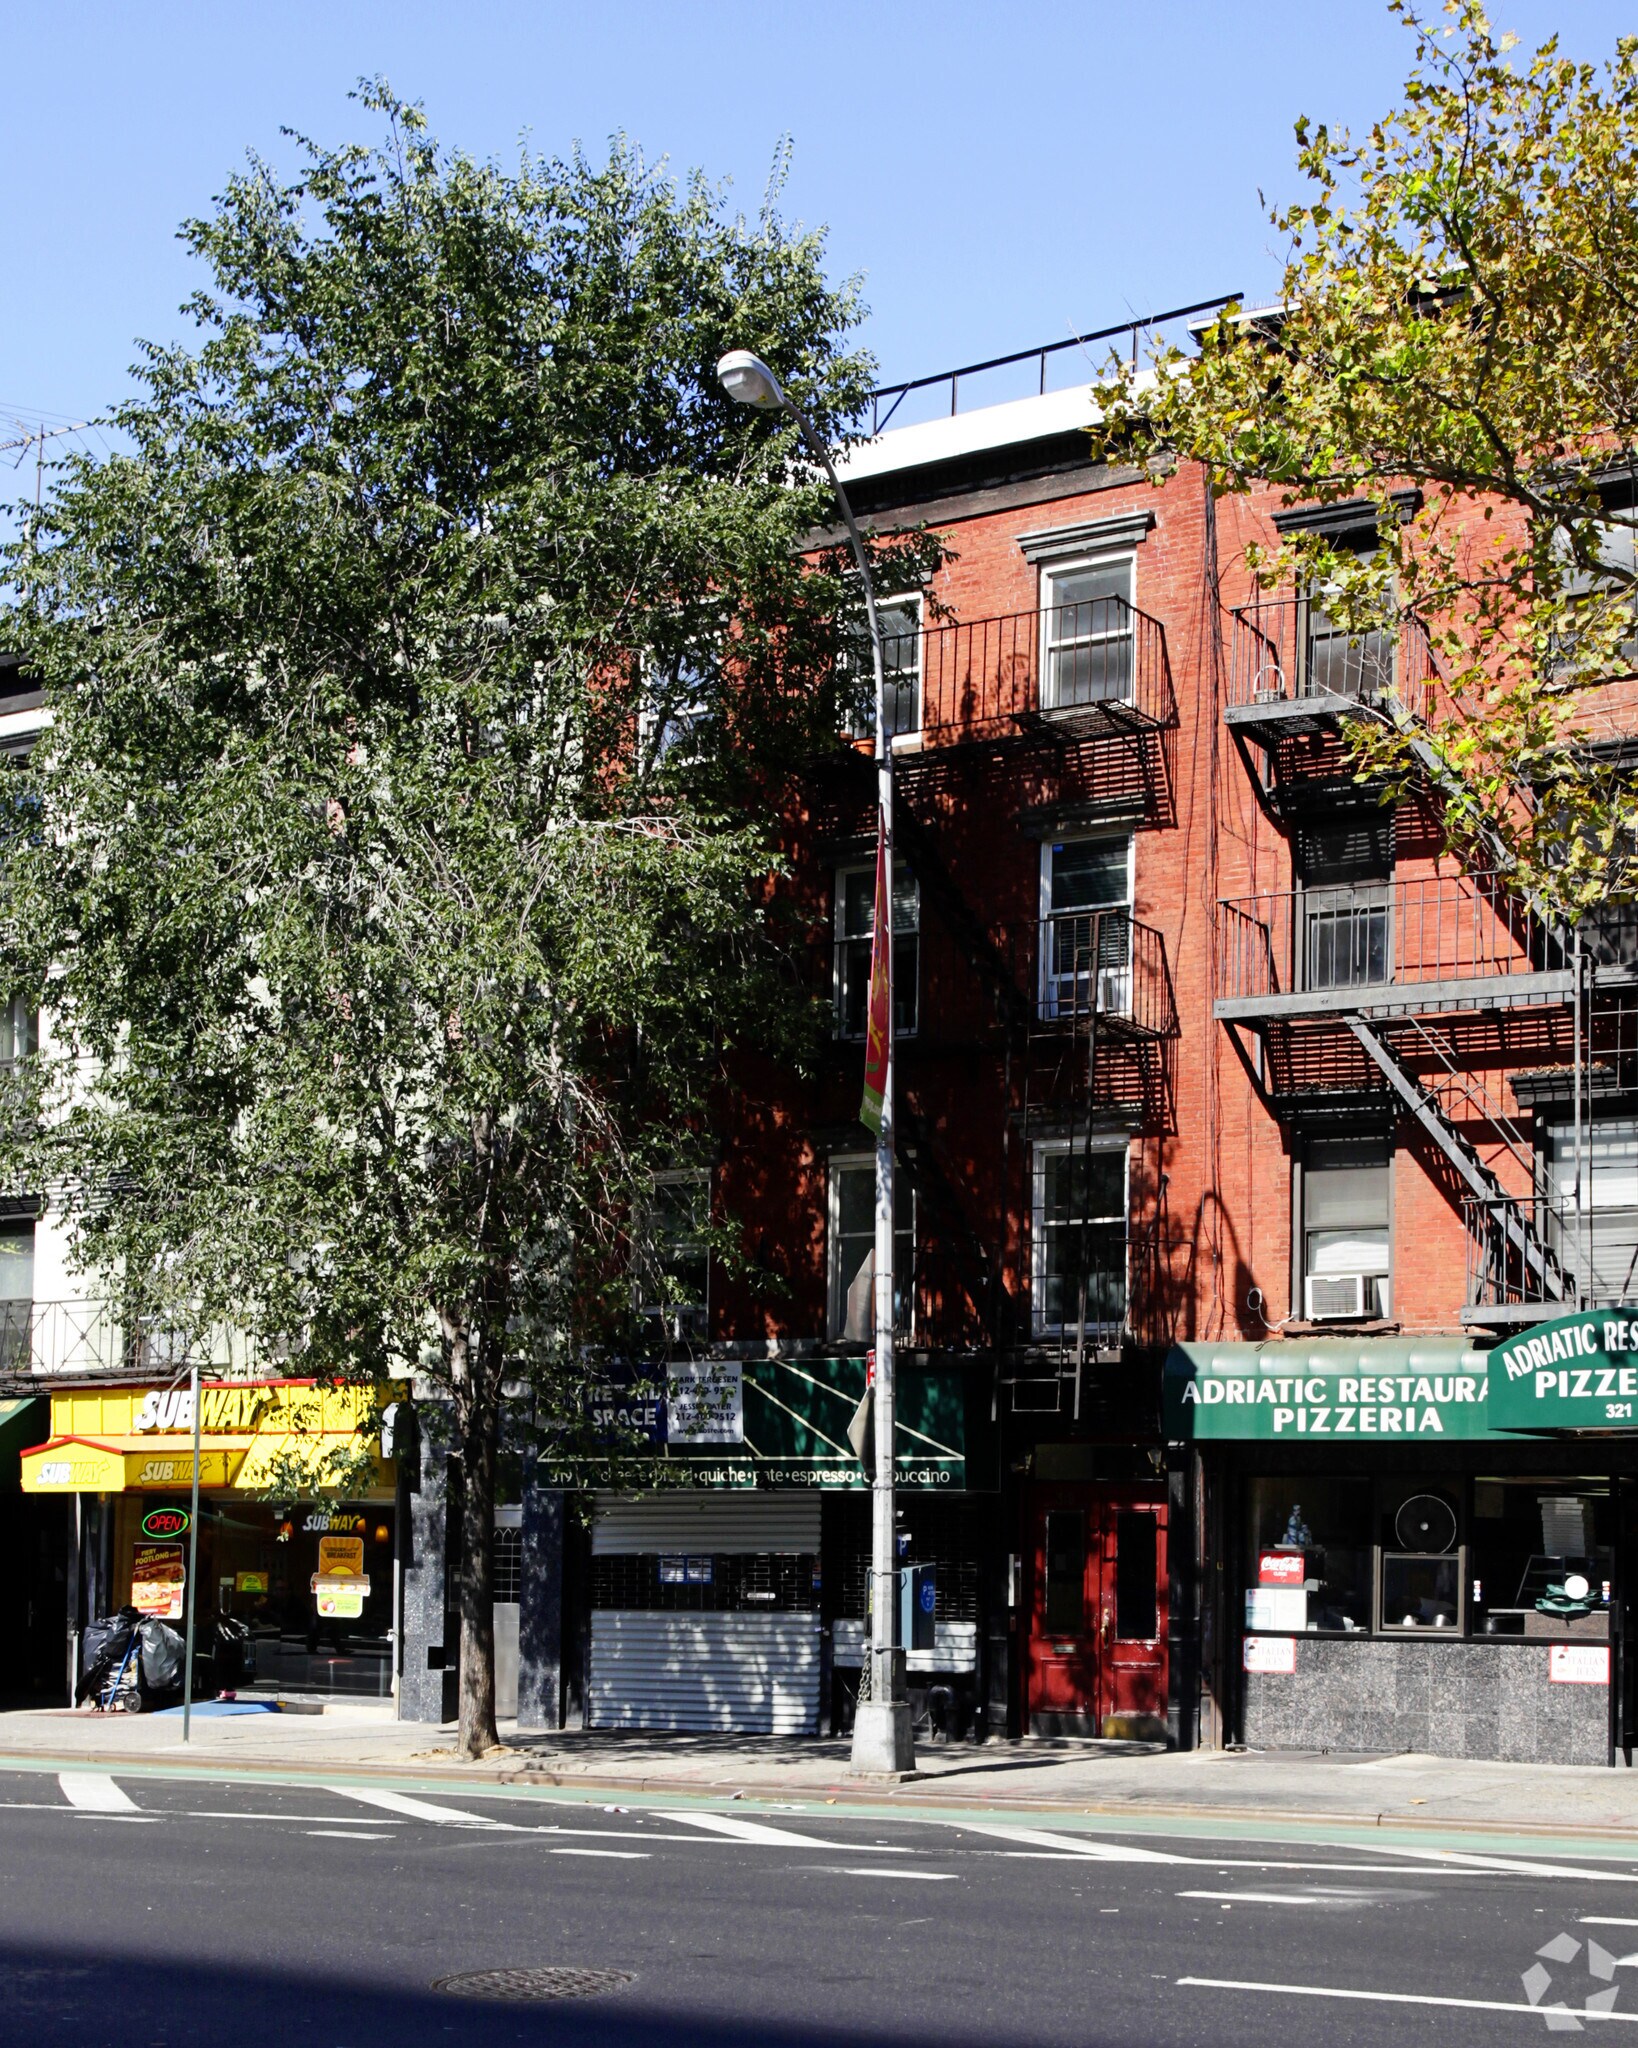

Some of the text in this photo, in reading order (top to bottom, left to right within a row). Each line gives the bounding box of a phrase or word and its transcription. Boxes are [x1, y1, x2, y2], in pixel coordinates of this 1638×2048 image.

[1502, 1324, 1598, 1381] ADRIATIC
[1181, 1379, 1327, 1404] ADRIATIC
[1535, 1368, 1637, 1398] PIZZE
[133, 1386, 273, 1430] SUBWAY
[592, 1407, 657, 1426] SPACE
[1273, 1407, 1443, 1432] PIZZERIA
[1605, 1403, 1632, 1418] 321
[37, 1460, 111, 1485] SUBWAY
[138, 1457, 212, 1485] SUBWAY
[699, 1466, 746, 1487] quiche
[791, 1469, 856, 1486] espresso
[863, 1467, 950, 1484] cuccino
[147, 1515, 181, 1531] OPEN
[302, 1514, 361, 1531] SUBWAY
[135, 1551, 170, 1566] FOOTLONG
